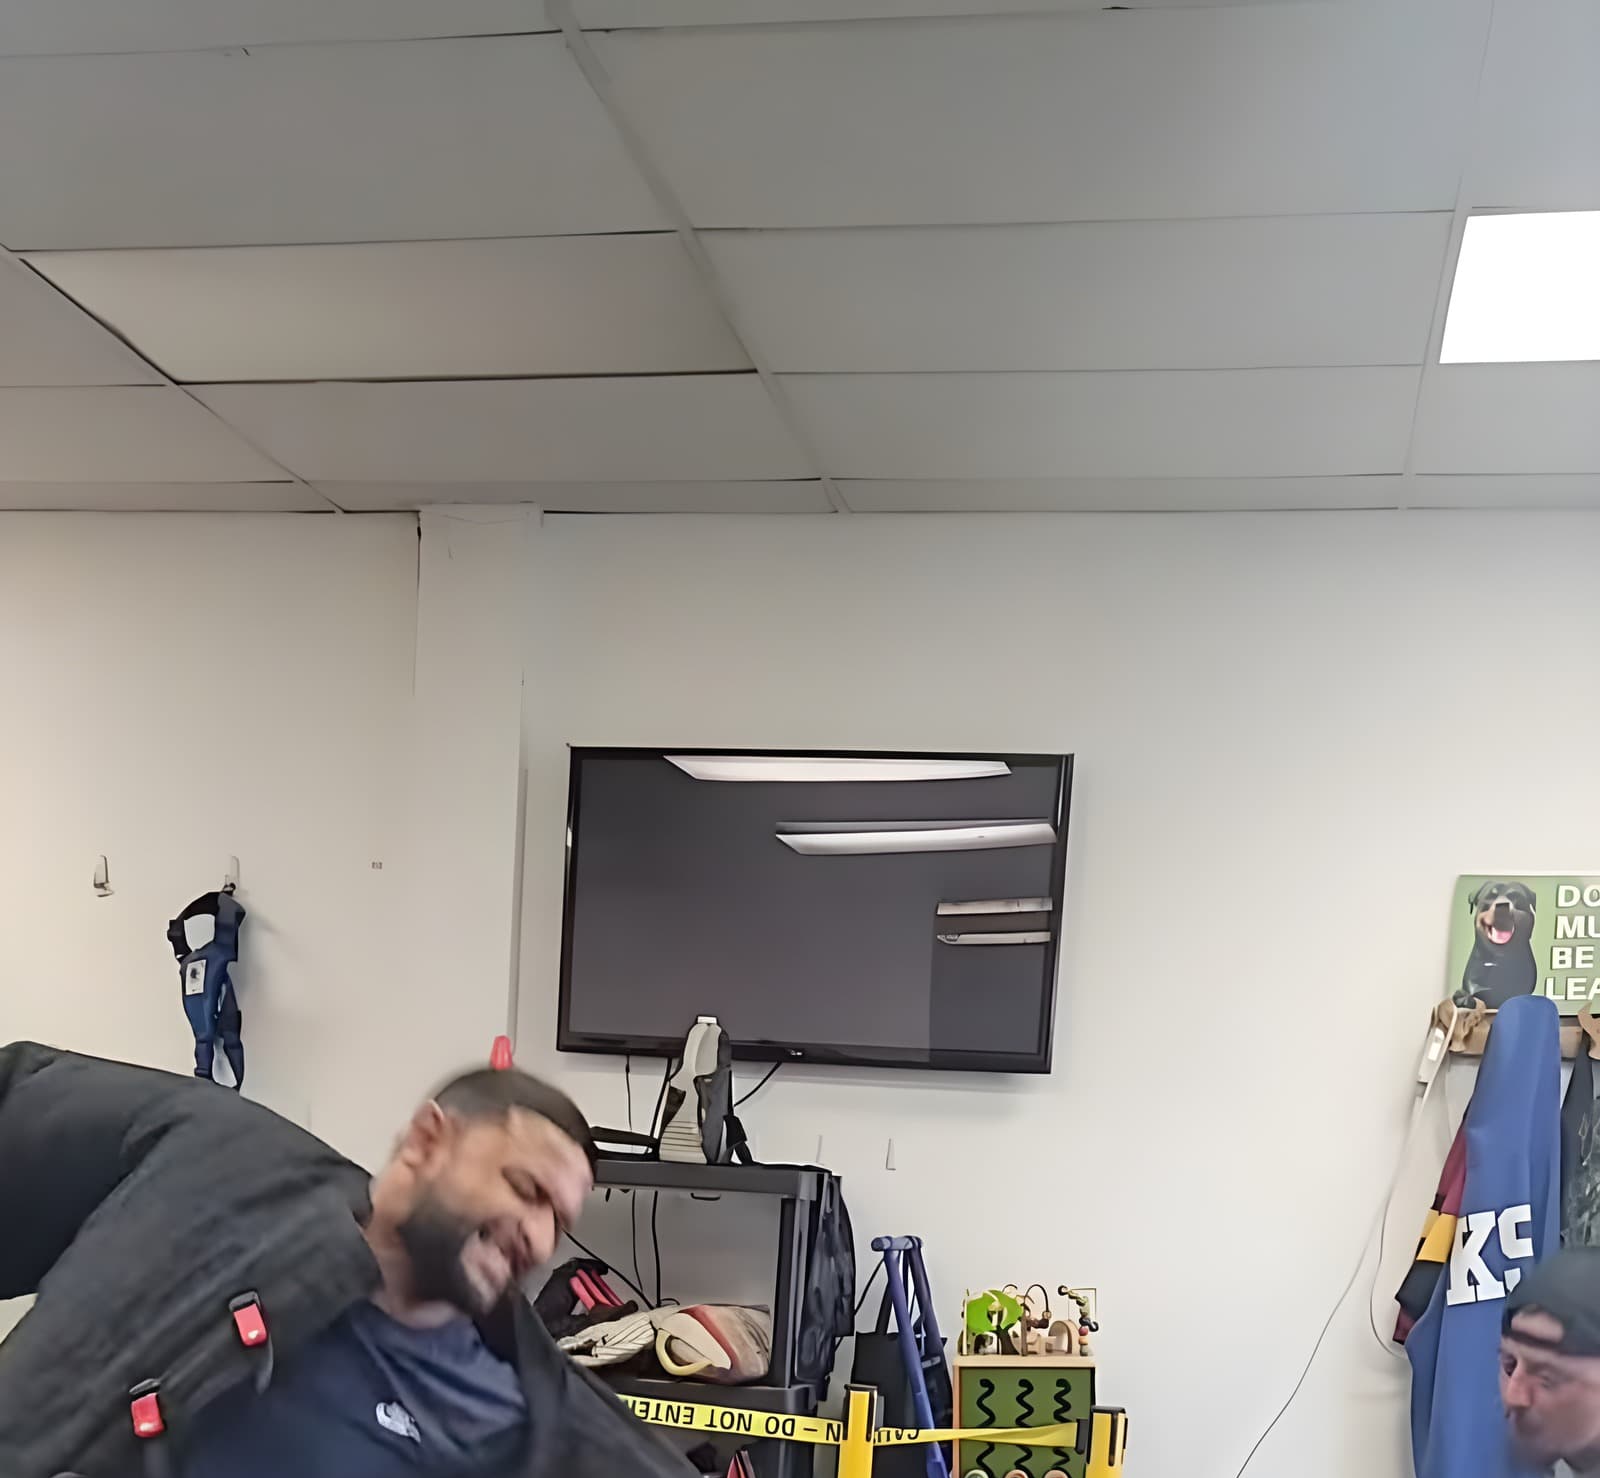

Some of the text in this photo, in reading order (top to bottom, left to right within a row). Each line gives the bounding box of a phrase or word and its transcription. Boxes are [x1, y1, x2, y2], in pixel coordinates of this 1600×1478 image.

[1551, 945, 1595, 970] BE
[704, 1408, 753, 1432] NOT
[765, 1416, 796, 1436] DO
